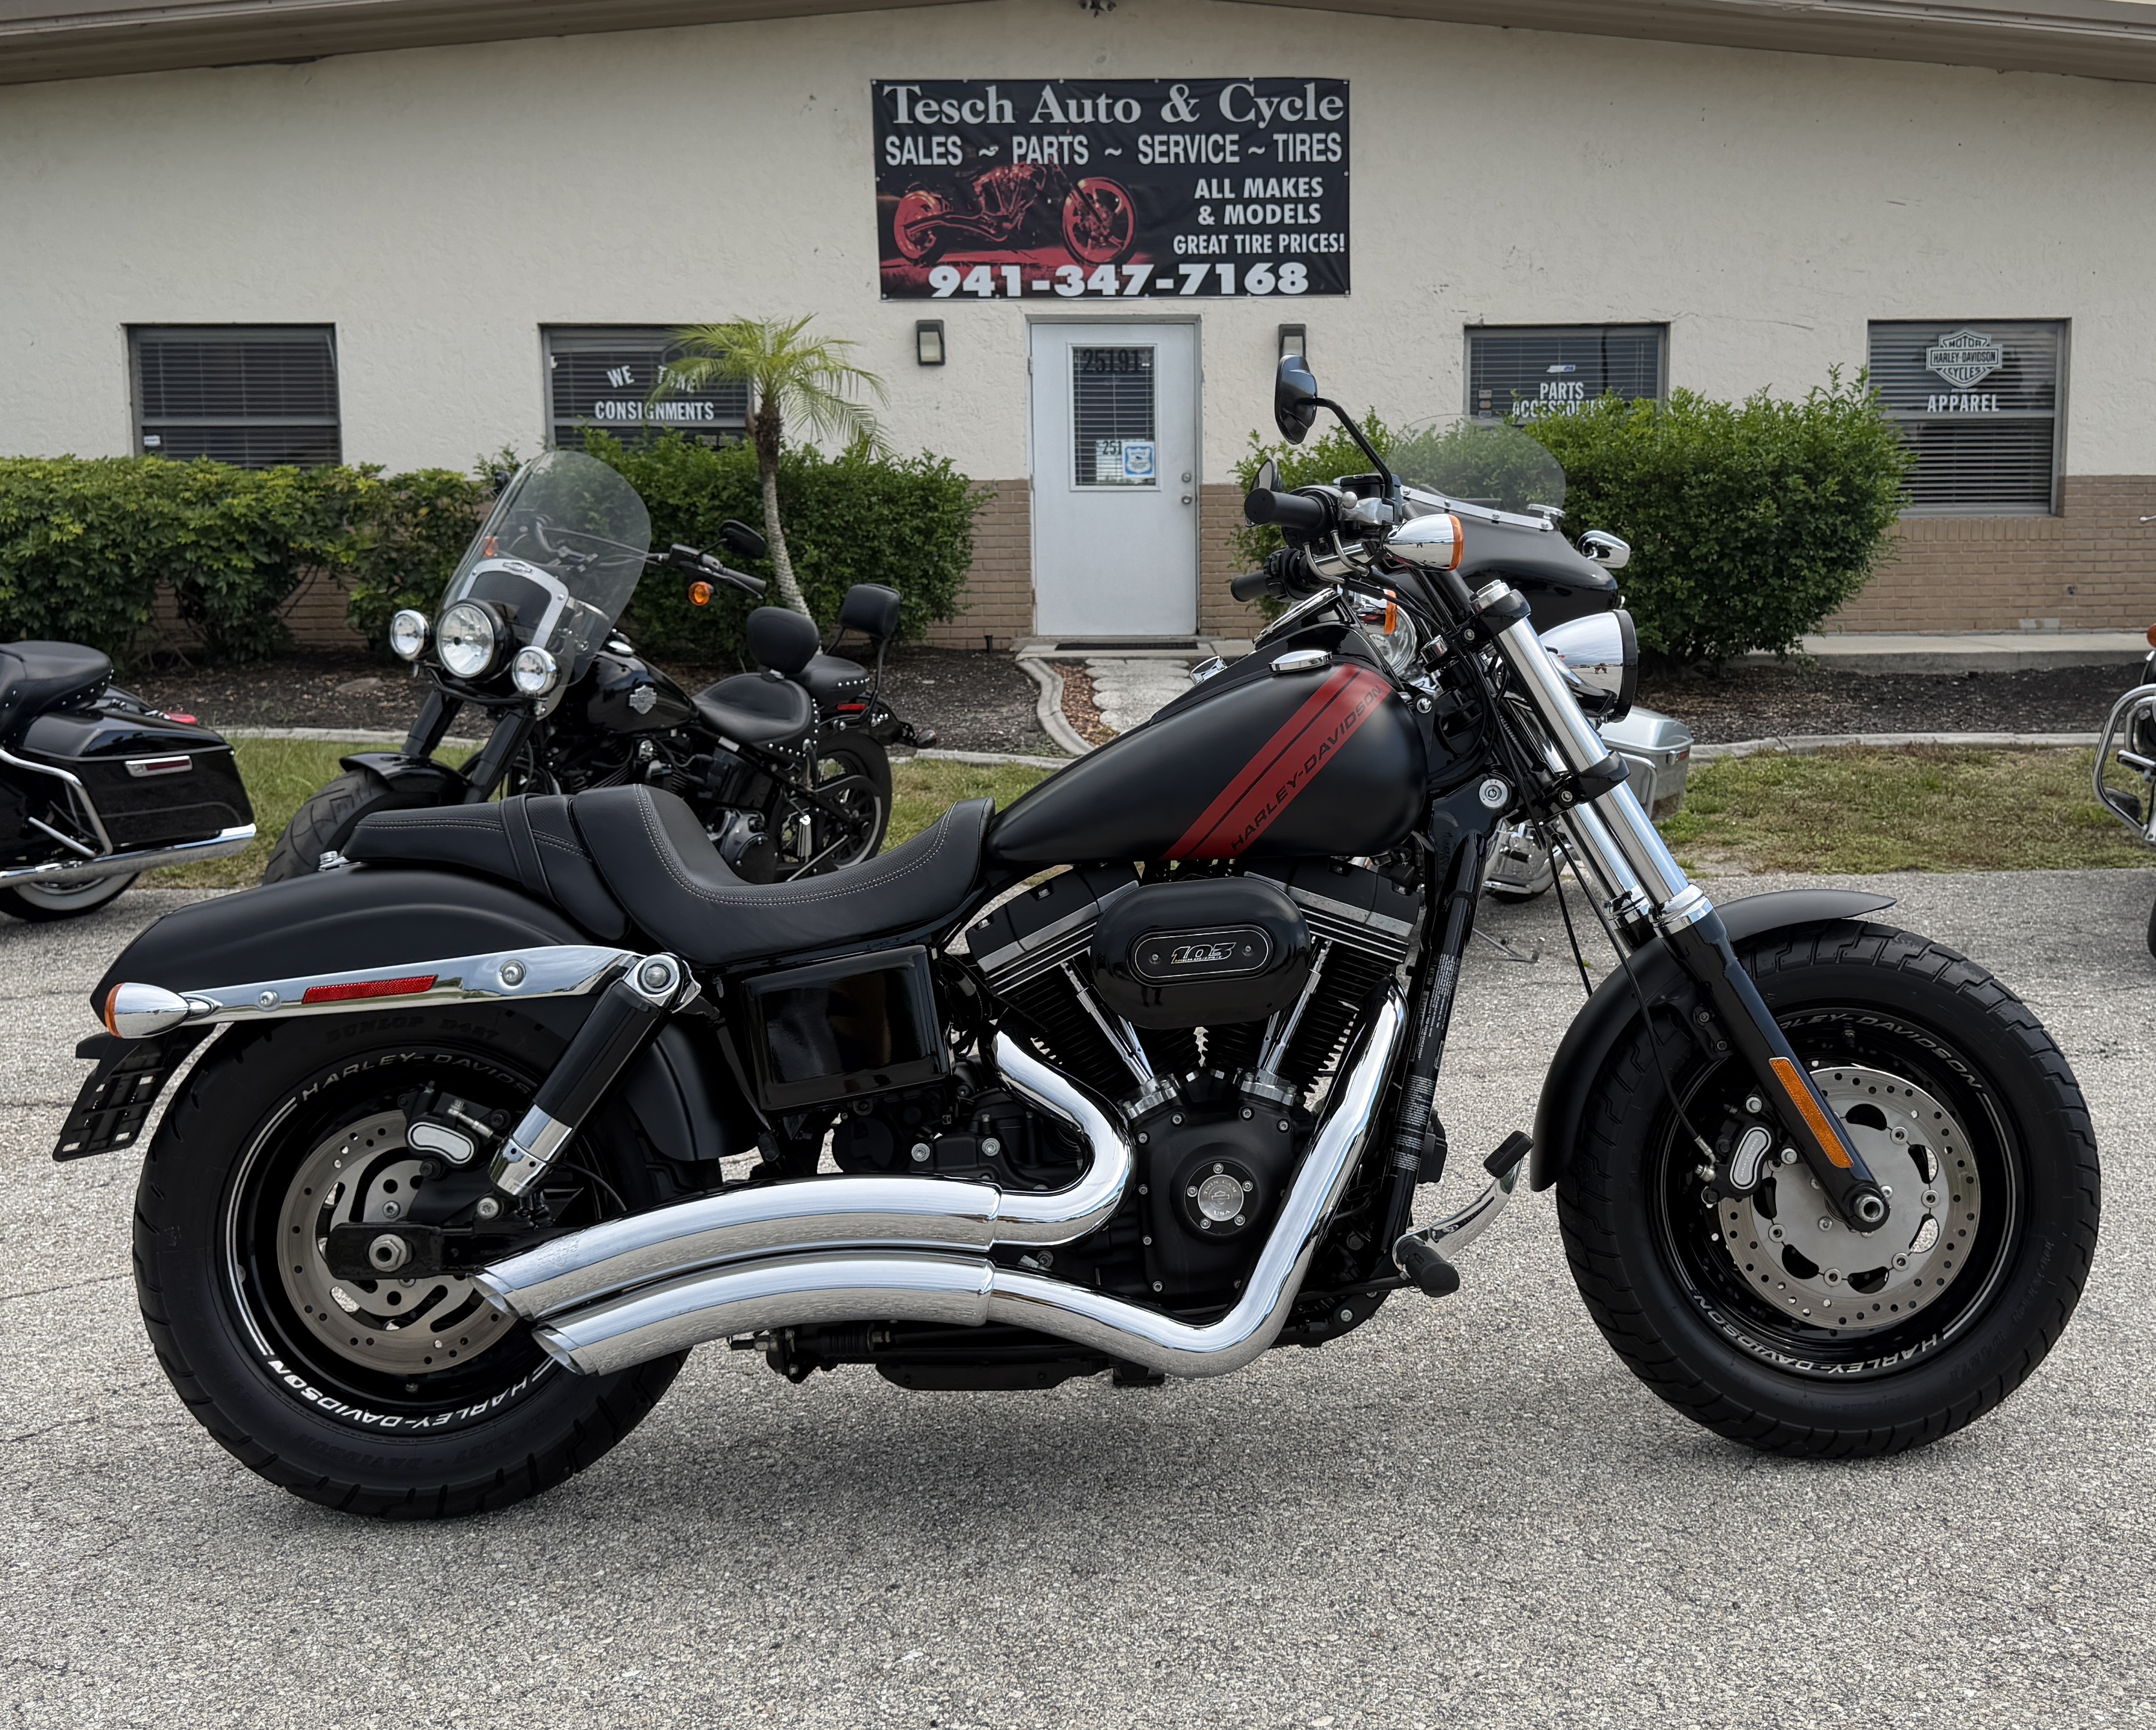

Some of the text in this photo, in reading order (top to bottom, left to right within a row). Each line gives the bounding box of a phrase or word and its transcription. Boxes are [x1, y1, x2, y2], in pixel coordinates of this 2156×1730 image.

[883, 82, 1343, 128] Tesch Auto & Cycle
[885, 135, 962, 165] SALES
[1012, 135, 1089, 165] PARTS
[1137, 134, 1240, 164] SERVICE
[1273, 132, 1342, 163] TIRES
[1194, 177, 1324, 199] ALL MAKES
[1198, 204, 1321, 226] & MODELS
[1173, 233, 1345, 255] GREAT TIRE PRICES!
[928, 262, 1309, 297] 941-347-7168
[1949, 336, 1981, 348] MOTOR
[1083, 349, 1138, 373] 25191
[1933, 351, 1996, 363] HARLEY-DAVIDSON
[607, 365, 635, 388] WE
[1948, 367, 1981, 380] CYCLES
[1540, 382, 1584, 400] PARTS
[594, 401, 714, 420] CONSIGNMENTS
[1927, 394, 2000, 412] APPAREL
[1230, 685, 1382, 851] HARLEY-DAVIDSON
[1171, 942, 1236, 964] 103
[1779, 1013, 1982, 1089] RLEY-DAVIDSON
[302, 1052, 531, 1101] HARLEY-DAVIDS
[1203, 1180, 1237, 1195] TWIN CAM
[1693, 1295, 1937, 1374] HARLEY-DAVIDSON
[268, 1360, 528, 1428] HARLEY-DAVIDSON
